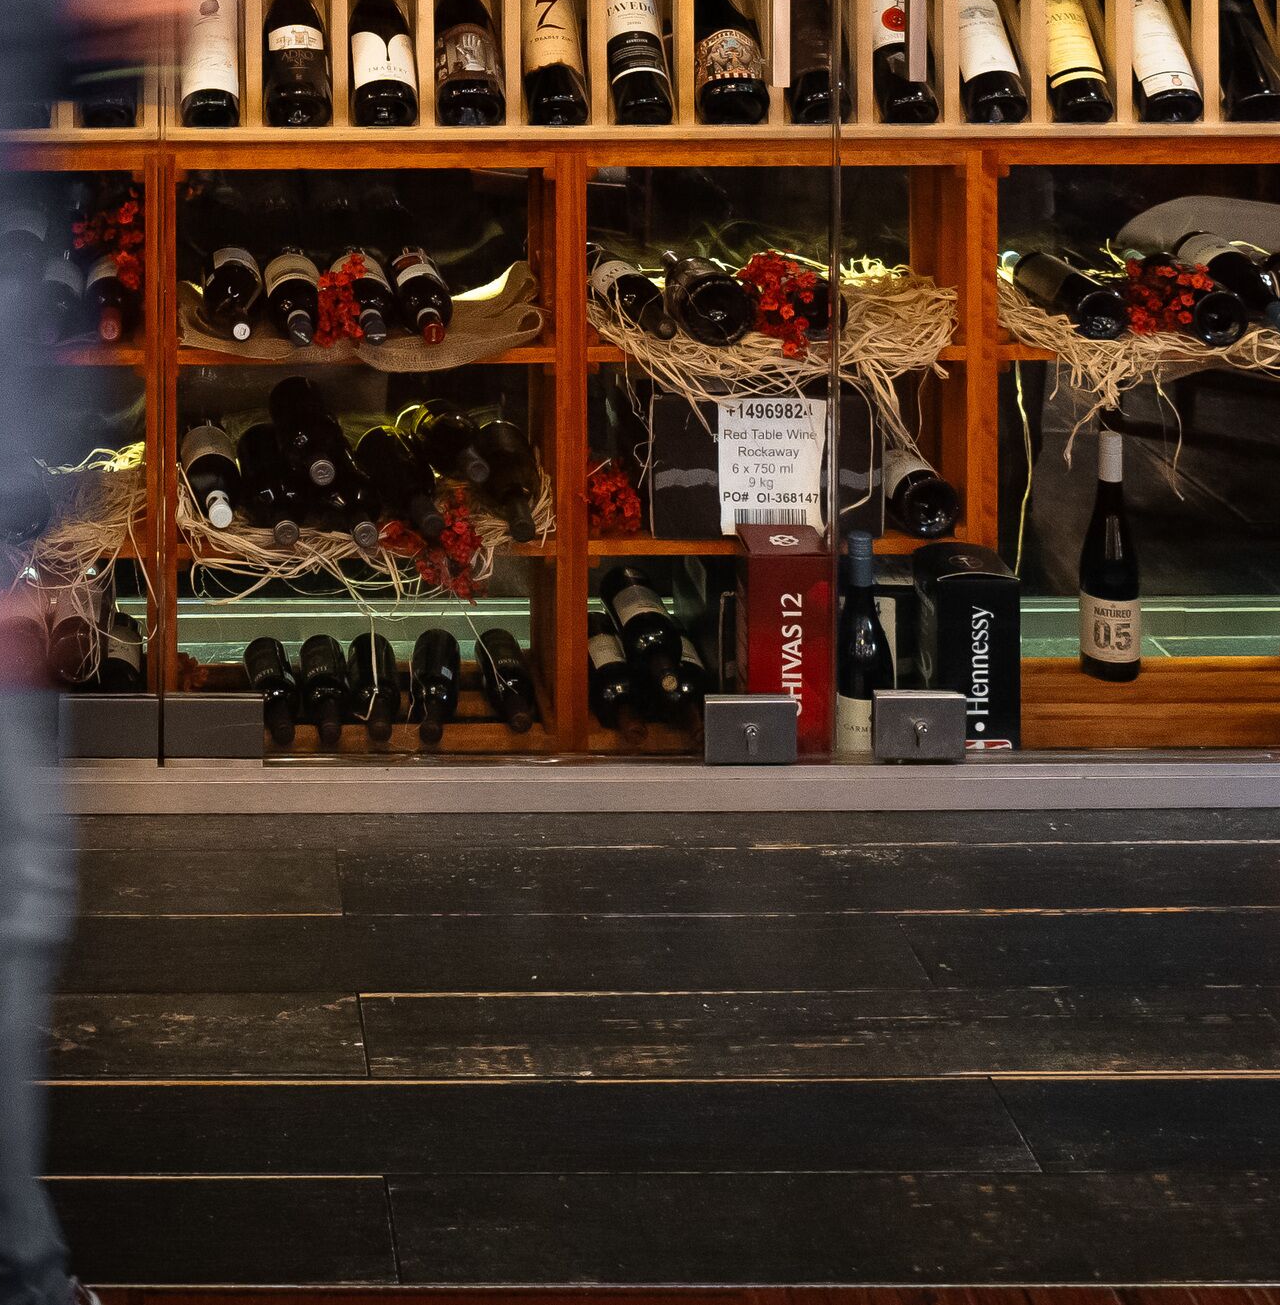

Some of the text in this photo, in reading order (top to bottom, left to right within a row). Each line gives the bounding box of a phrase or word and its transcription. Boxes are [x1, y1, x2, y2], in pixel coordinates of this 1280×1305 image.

[723, 429, 748, 440] Red
[751, 428, 783, 440] Table
[786, 429, 818, 440] Wine
[738, 446, 800, 459] Rockaway
[732, 463, 794, 474] 6 x 750 ml
[749, 477, 774, 490] 9 kg
[723, 492, 749, 502] PO#
[781, 593, 803, 618] 12
[1094, 606, 1132, 619] NATUREO
[1094, 619, 1133, 651] 0.5
[966, 605, 995, 715] Hennessy
